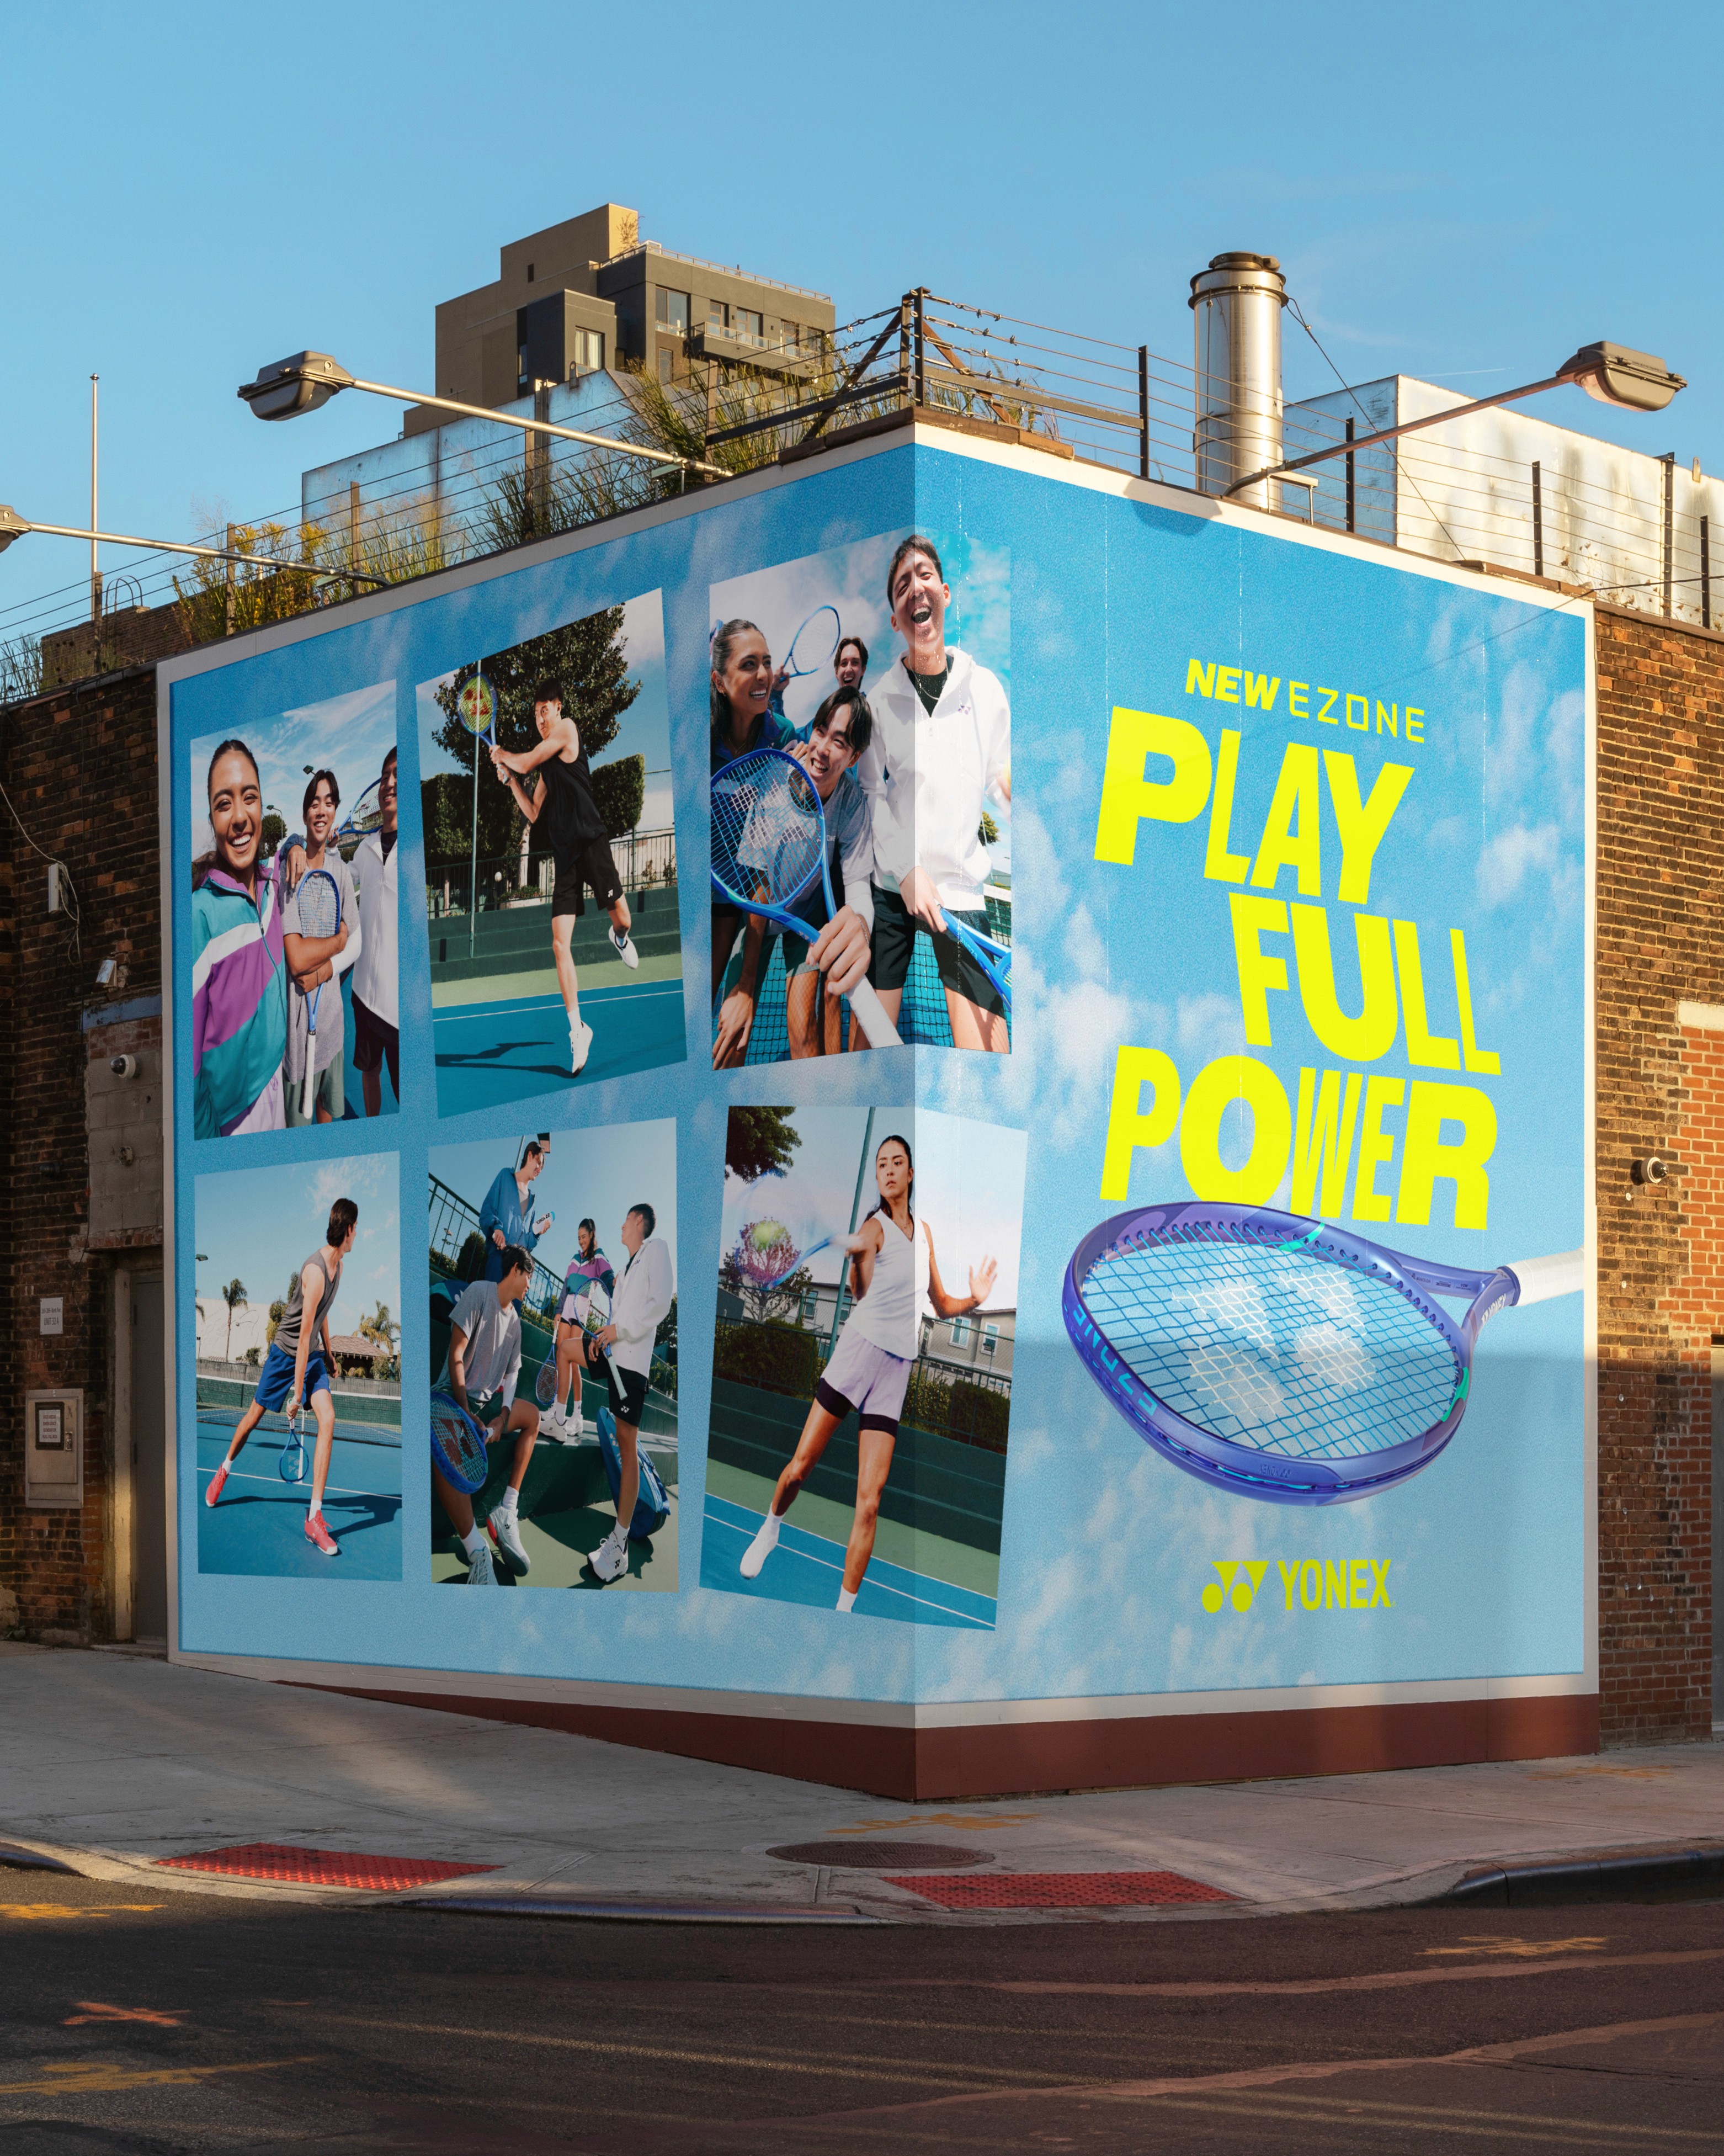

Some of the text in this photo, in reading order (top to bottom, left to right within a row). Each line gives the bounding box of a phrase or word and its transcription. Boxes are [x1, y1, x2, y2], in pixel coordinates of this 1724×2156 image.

[1186, 659, 1424, 743] NEW EZONE
[1094, 706, 1415, 905] PLAY
[1229, 893, 1501, 1075] FULL
[1100, 1045, 1497, 1230] POWER
[1277, 1559, 1391, 1611] YONEX
